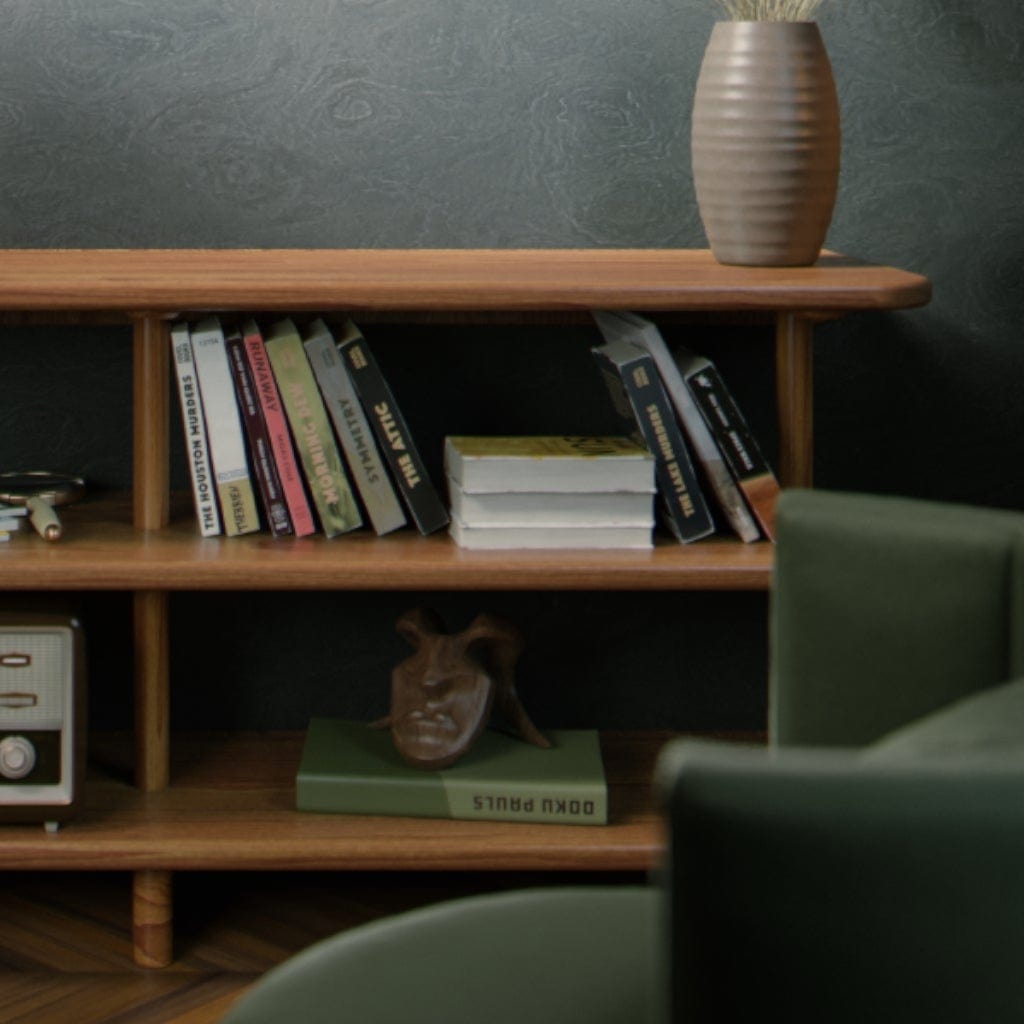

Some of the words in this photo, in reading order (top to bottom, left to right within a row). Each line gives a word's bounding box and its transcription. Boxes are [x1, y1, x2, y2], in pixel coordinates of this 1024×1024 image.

[249, 341, 278, 412] RUNAWAY
[182, 375, 203, 434] MURDERS
[374, 401, 408, 454] ATTIC
[340, 398, 378, 484] SYMMETRY
[646, 404, 676, 461] MURDERS
[193, 435, 212, 503] HOUSTON
[301, 416, 340, 505] MORNING
[397, 456, 422, 489] THE
[203, 505, 215, 530] THE
[677, 493, 695, 518] THE
[473, 795, 535, 813] PAULS
[541, 798, 594, 816] DOKU
